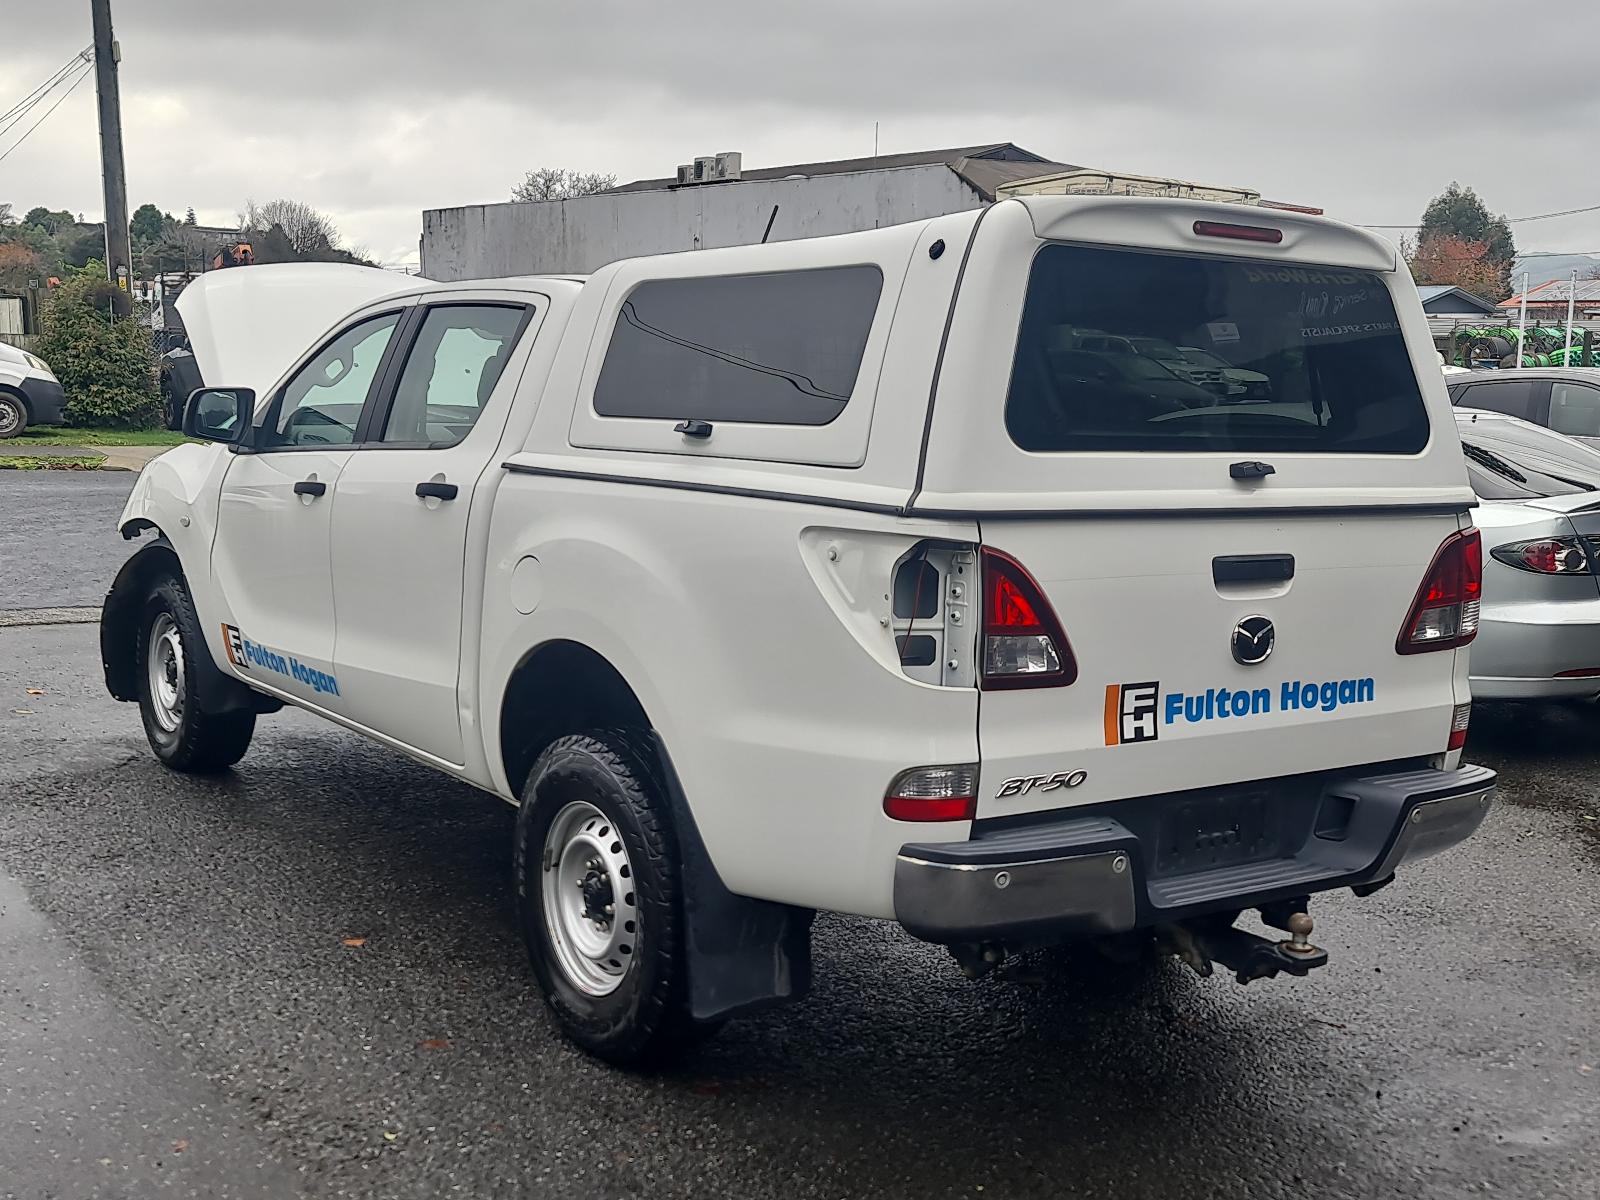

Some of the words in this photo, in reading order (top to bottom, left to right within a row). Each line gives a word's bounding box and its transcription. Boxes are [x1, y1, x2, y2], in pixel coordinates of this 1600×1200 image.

[243, 640, 290, 677] Fulton
[288, 656, 340, 697] Hogan
[1165, 687, 1271, 725] Fulton
[1280, 677, 1374, 712] Hogan
[995, 768, 1088, 799] BT-50
